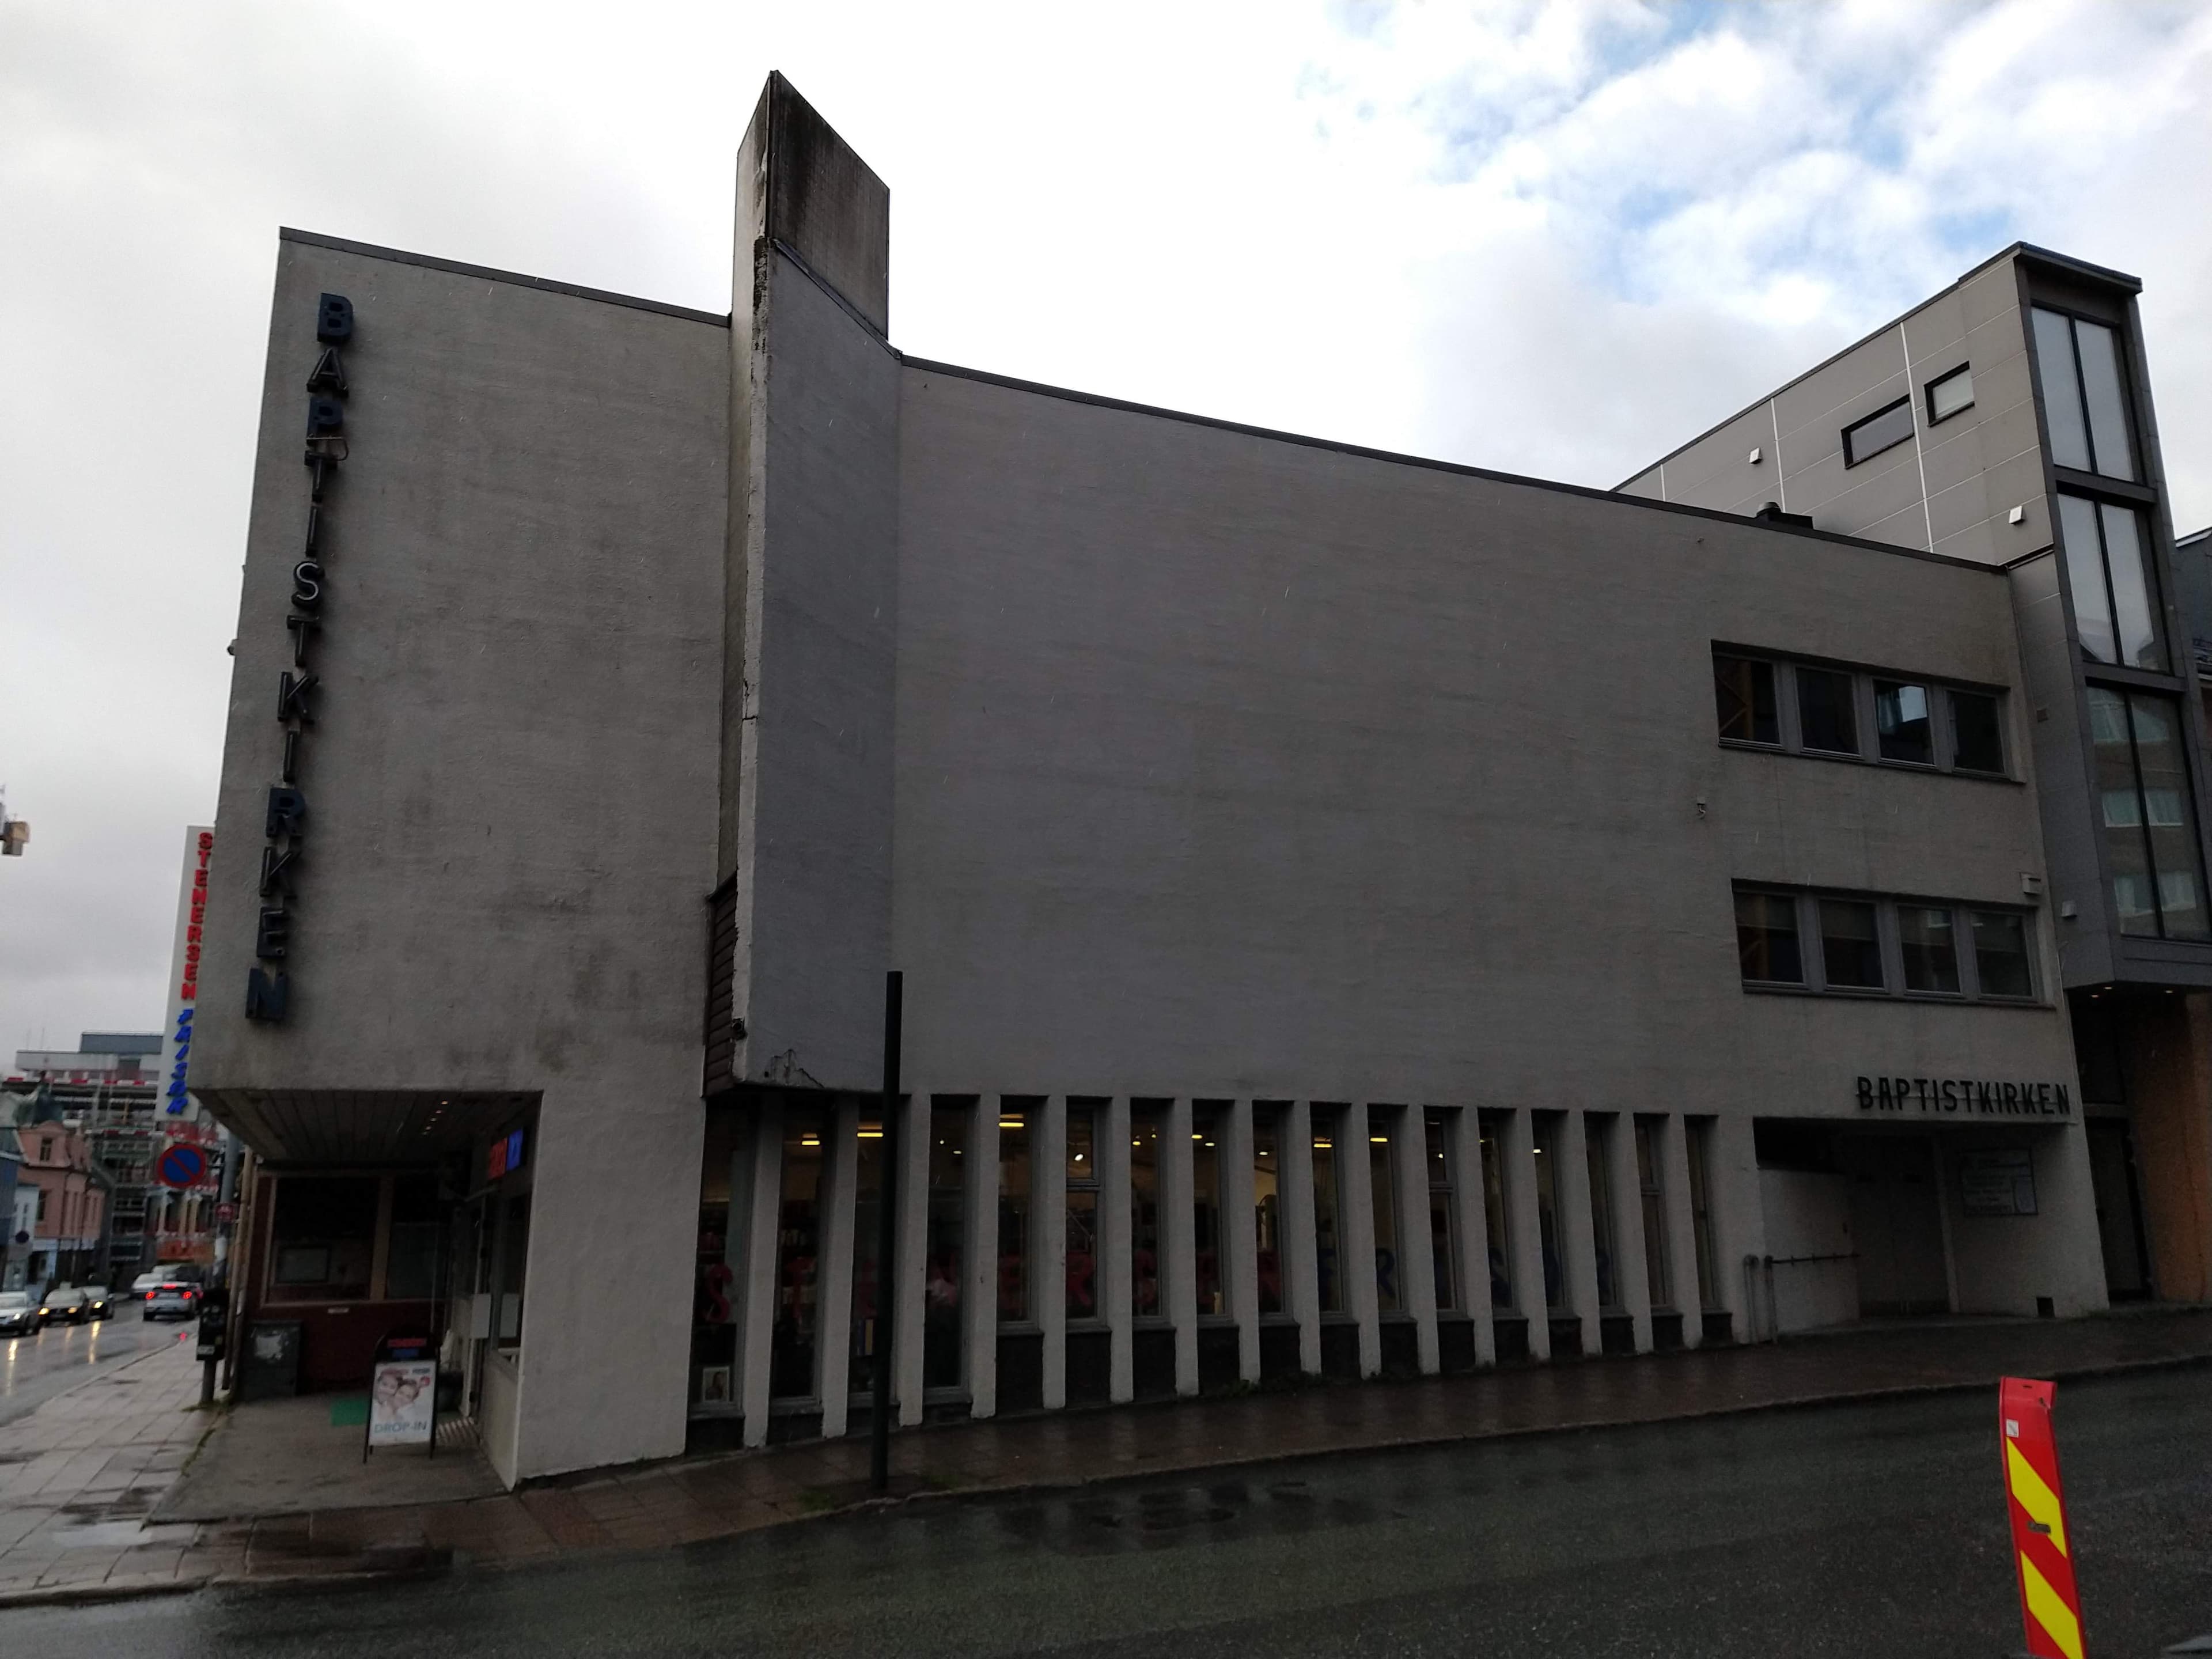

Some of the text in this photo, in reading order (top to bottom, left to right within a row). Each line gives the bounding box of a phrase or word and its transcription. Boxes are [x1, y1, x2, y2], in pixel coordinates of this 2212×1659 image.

[245, 293, 354, 1020] BAPTISTKIRKEN
[181, 832, 213, 1001] STENERSEN
[1857, 1076, 2070, 1115] BAPTISTKIRKEN
[374, 1421, 427, 1434] DROP-IN
